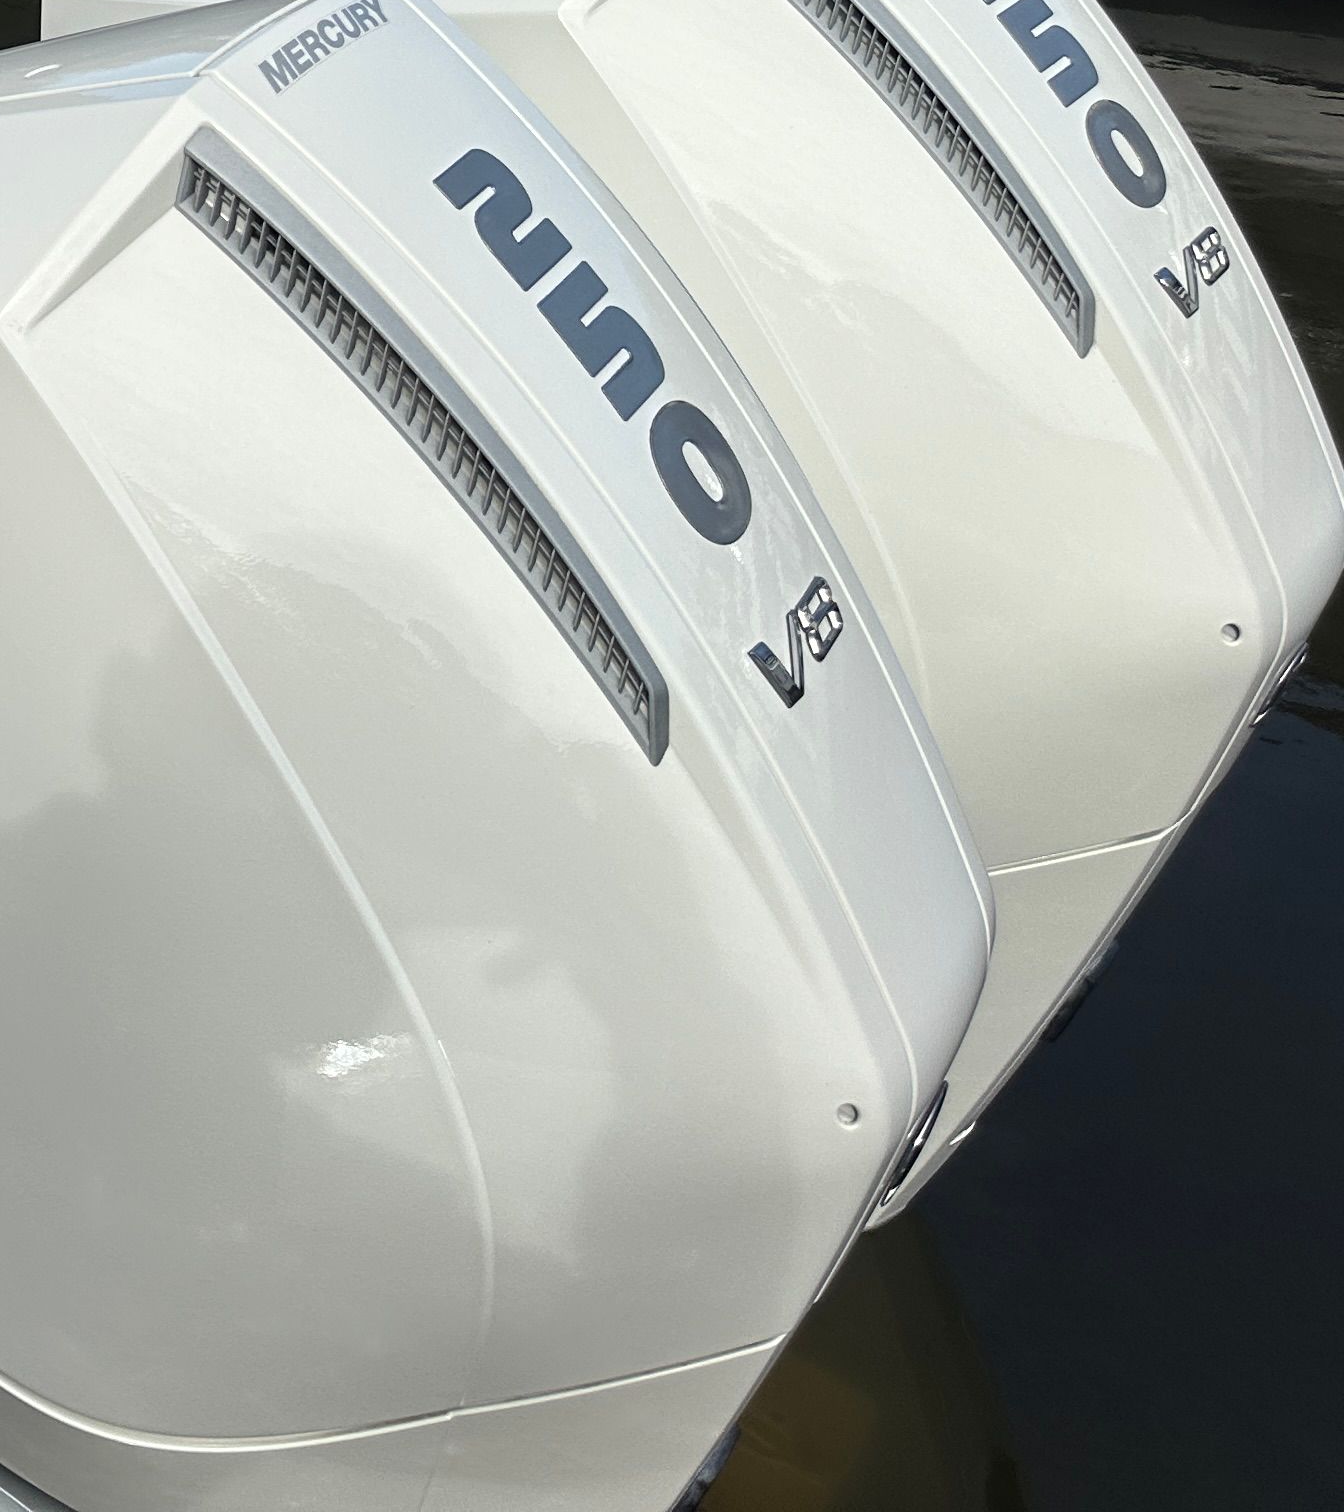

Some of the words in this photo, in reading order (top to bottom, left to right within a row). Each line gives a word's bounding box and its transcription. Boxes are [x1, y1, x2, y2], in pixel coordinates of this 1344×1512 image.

[1153, 225, 1231, 318] V8
[432, 148, 753, 546] 250
[746, 575, 844, 709] V8
